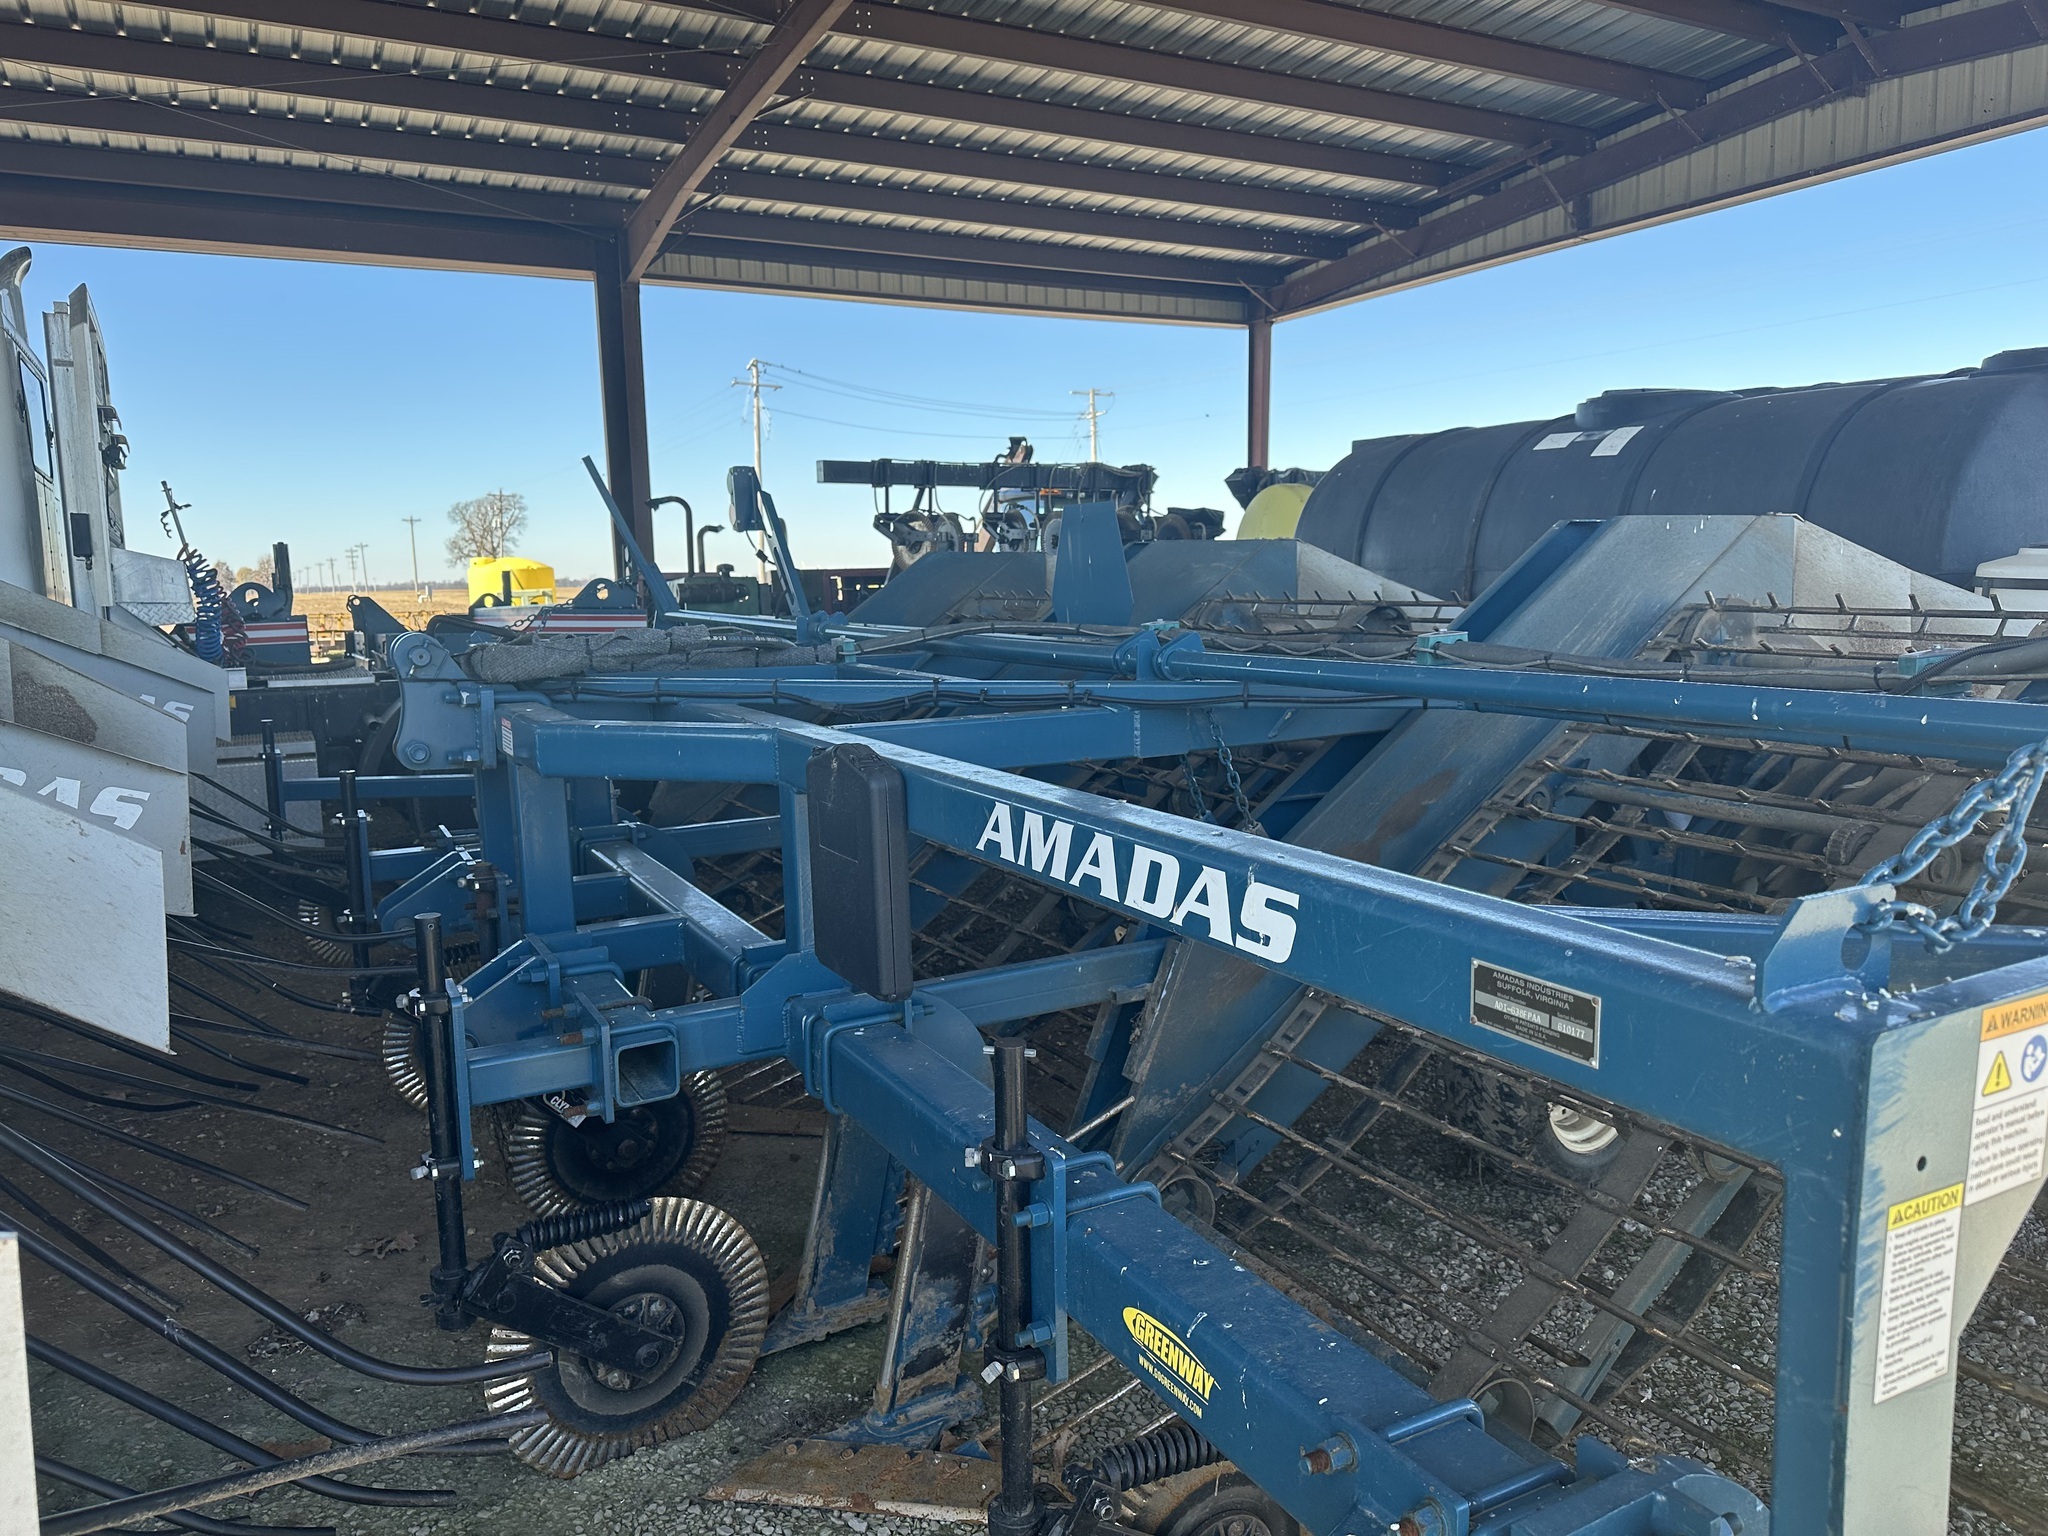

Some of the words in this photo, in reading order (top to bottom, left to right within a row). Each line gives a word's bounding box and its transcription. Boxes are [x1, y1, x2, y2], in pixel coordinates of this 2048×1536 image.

[975, 802, 1300, 963] AMADAS
[1493, 971, 1525, 987] AMADAS
[1526, 982, 1574, 1003] INDUSTRIES
[1497, 981, 1533, 999] SUFFOLK,
[1535, 993, 1570, 1010] VIRGINIA
[1557, 1022, 1585, 1039] 610177
[1904, 1189, 1959, 1220] CAUTION
[1135, 1313, 1214, 1401] GREENWAY
